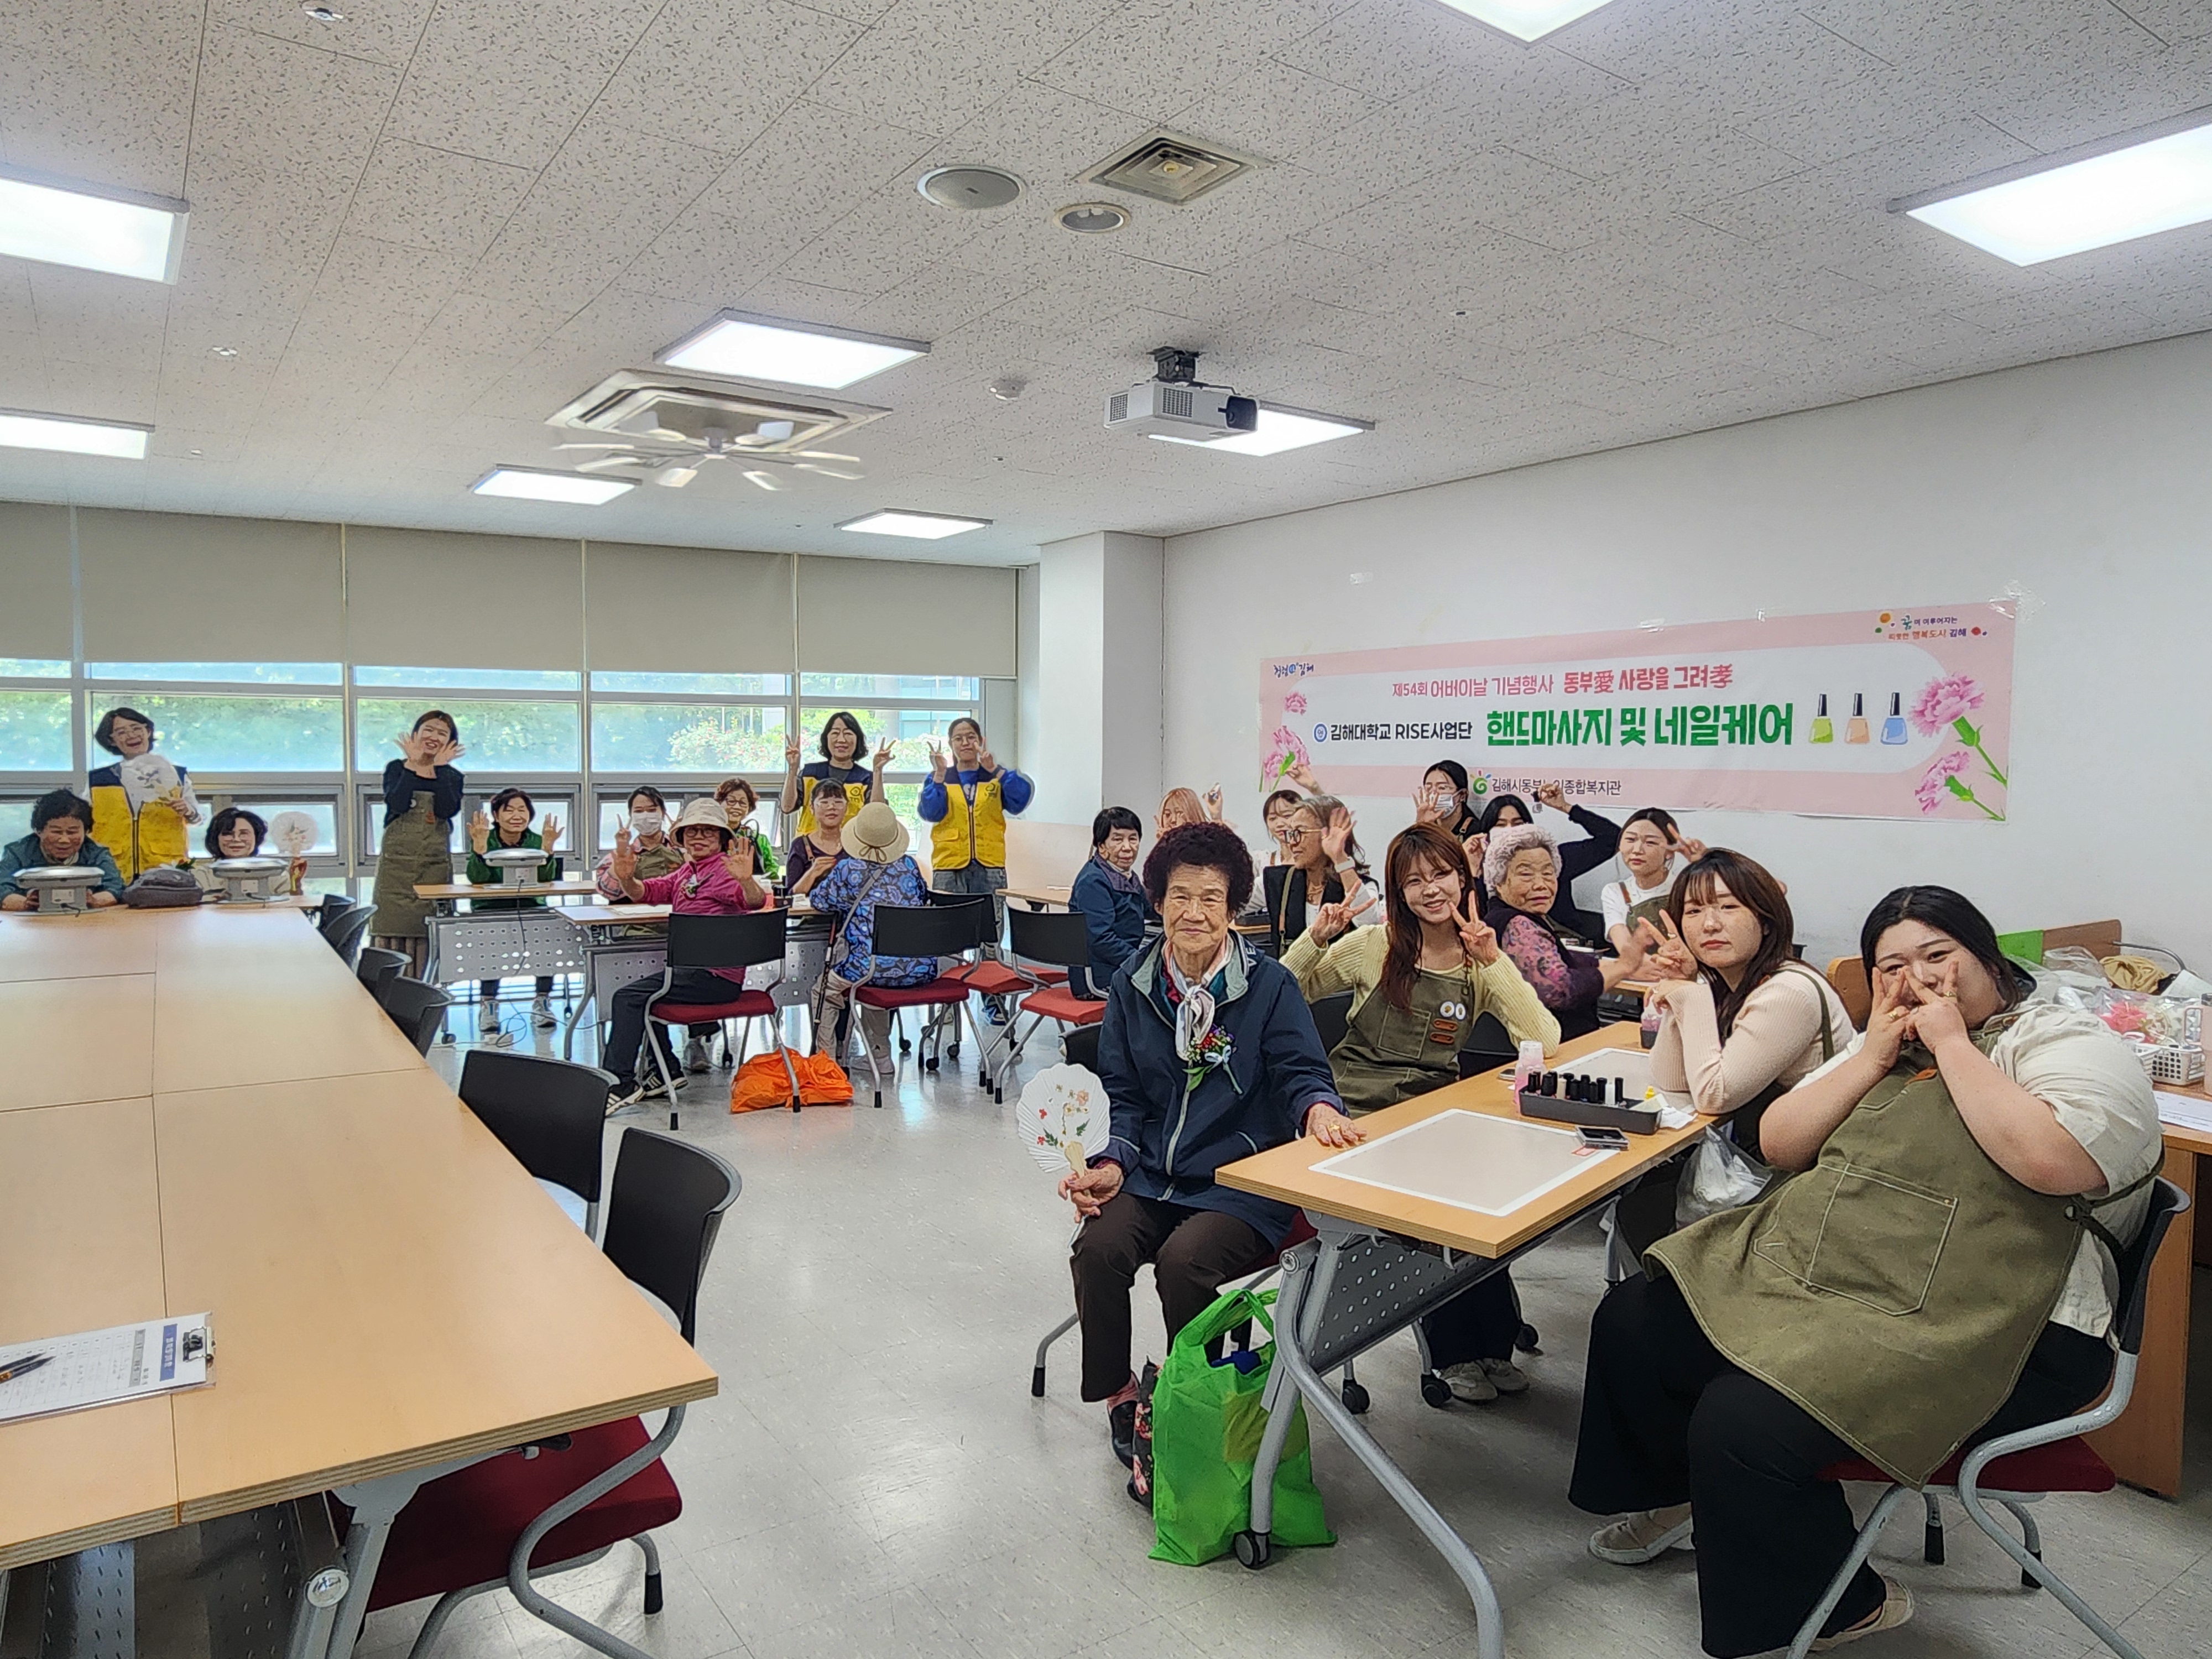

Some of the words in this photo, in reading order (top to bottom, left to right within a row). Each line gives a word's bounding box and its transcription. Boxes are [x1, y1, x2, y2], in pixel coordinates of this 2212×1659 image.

[1949, 628, 1967, 638] 김해
[1392, 681, 1428, 697] 제54회
[1431, 677, 1488, 698] 어버이날
[1491, 674, 1554, 696] 기념행사
[1564, 670, 1614, 694] 동부愛
[1618, 666, 1669, 691] 사랑을
[1673, 664, 1733, 689] 그려孝
[1331, 723, 1391, 741] 김해대학교
[1395, 722, 1473, 740] RISE사업단
[1487, 707, 1612, 746] 핸드마사지
[1620, 707, 1647, 747] 및
[1655, 703, 1793, 746] 네일케어
[1491, 778, 1621, 796] 김해시동부종합복지관
